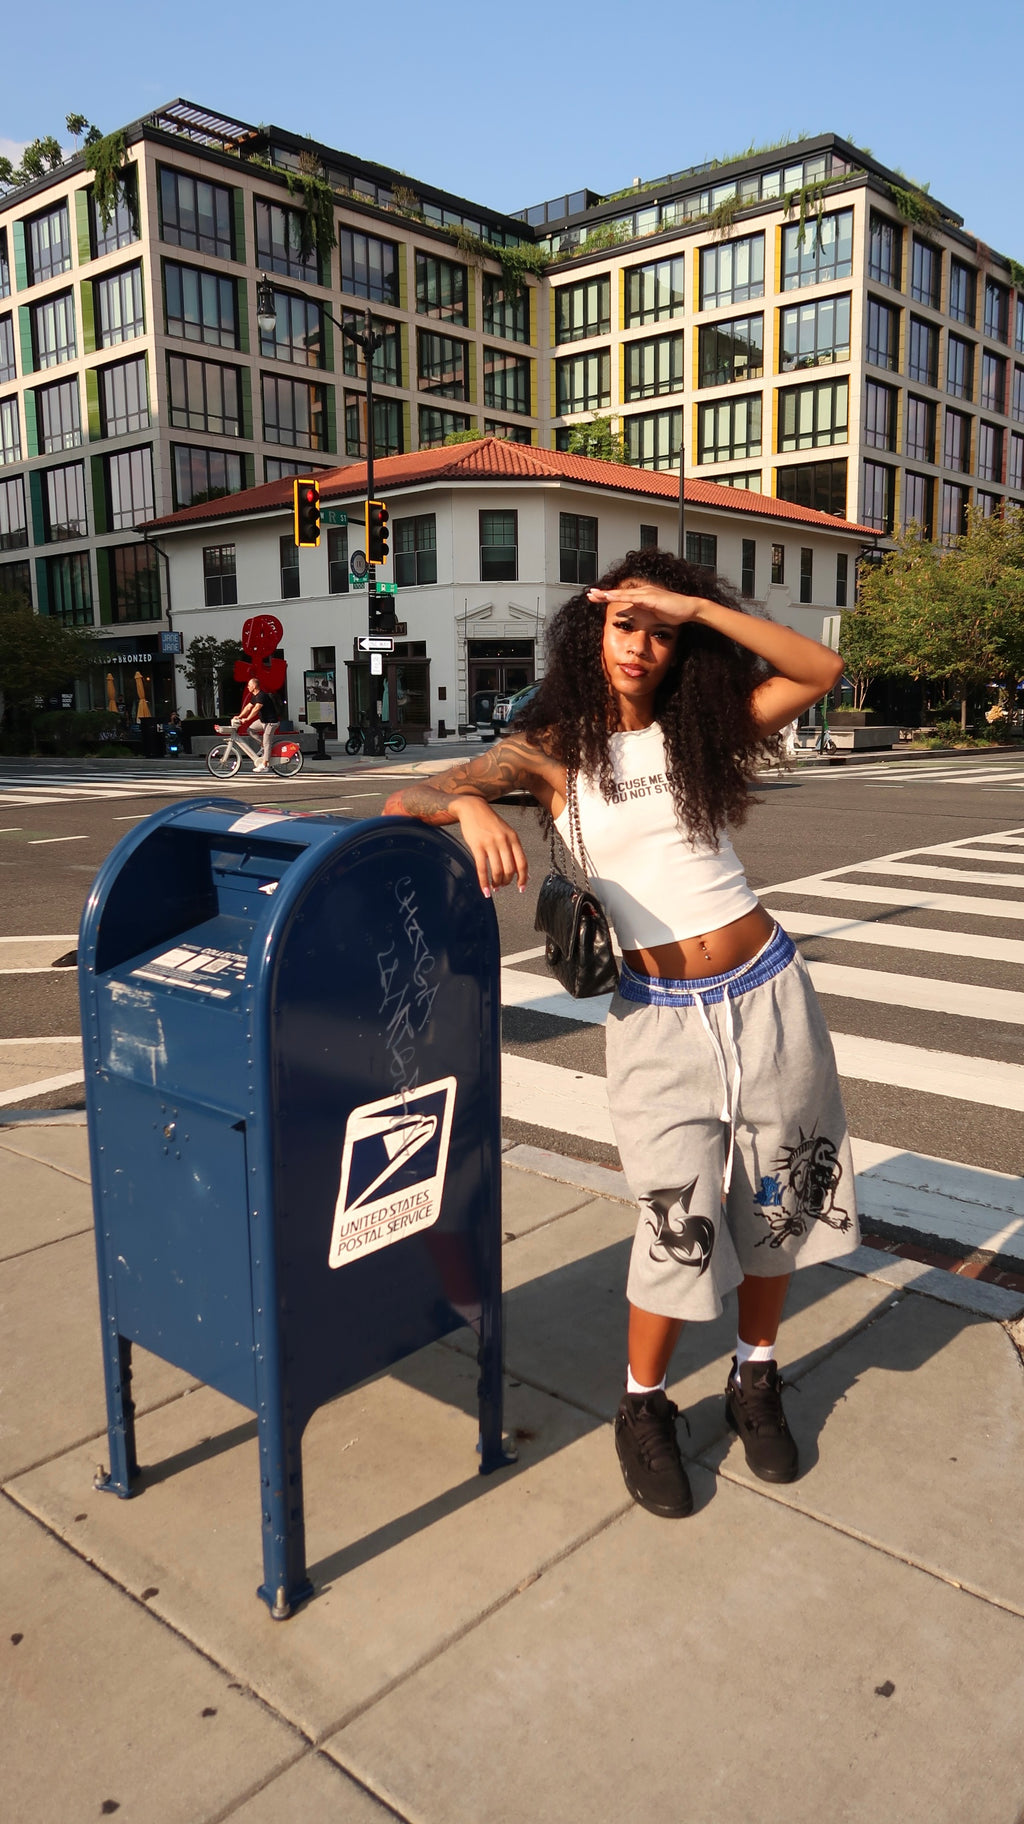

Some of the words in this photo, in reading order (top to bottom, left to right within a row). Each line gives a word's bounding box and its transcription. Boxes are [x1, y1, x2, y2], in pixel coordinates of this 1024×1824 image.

[328, 510, 337, 524] R
[340, 514, 347, 522] ST
[162, 634, 179, 642] JANE
[162, 643, 179, 652] JANE
[648, 773, 664, 785] ME
[604, 792, 628, 806] YOU
[629, 786, 652, 800] NOT
[340, 1208, 388, 1238] UNITED
[390, 1190, 430, 1216] STATES
[337, 1226, 383, 1256] POSTAL
[387, 1204, 432, 1234] SERVICE
